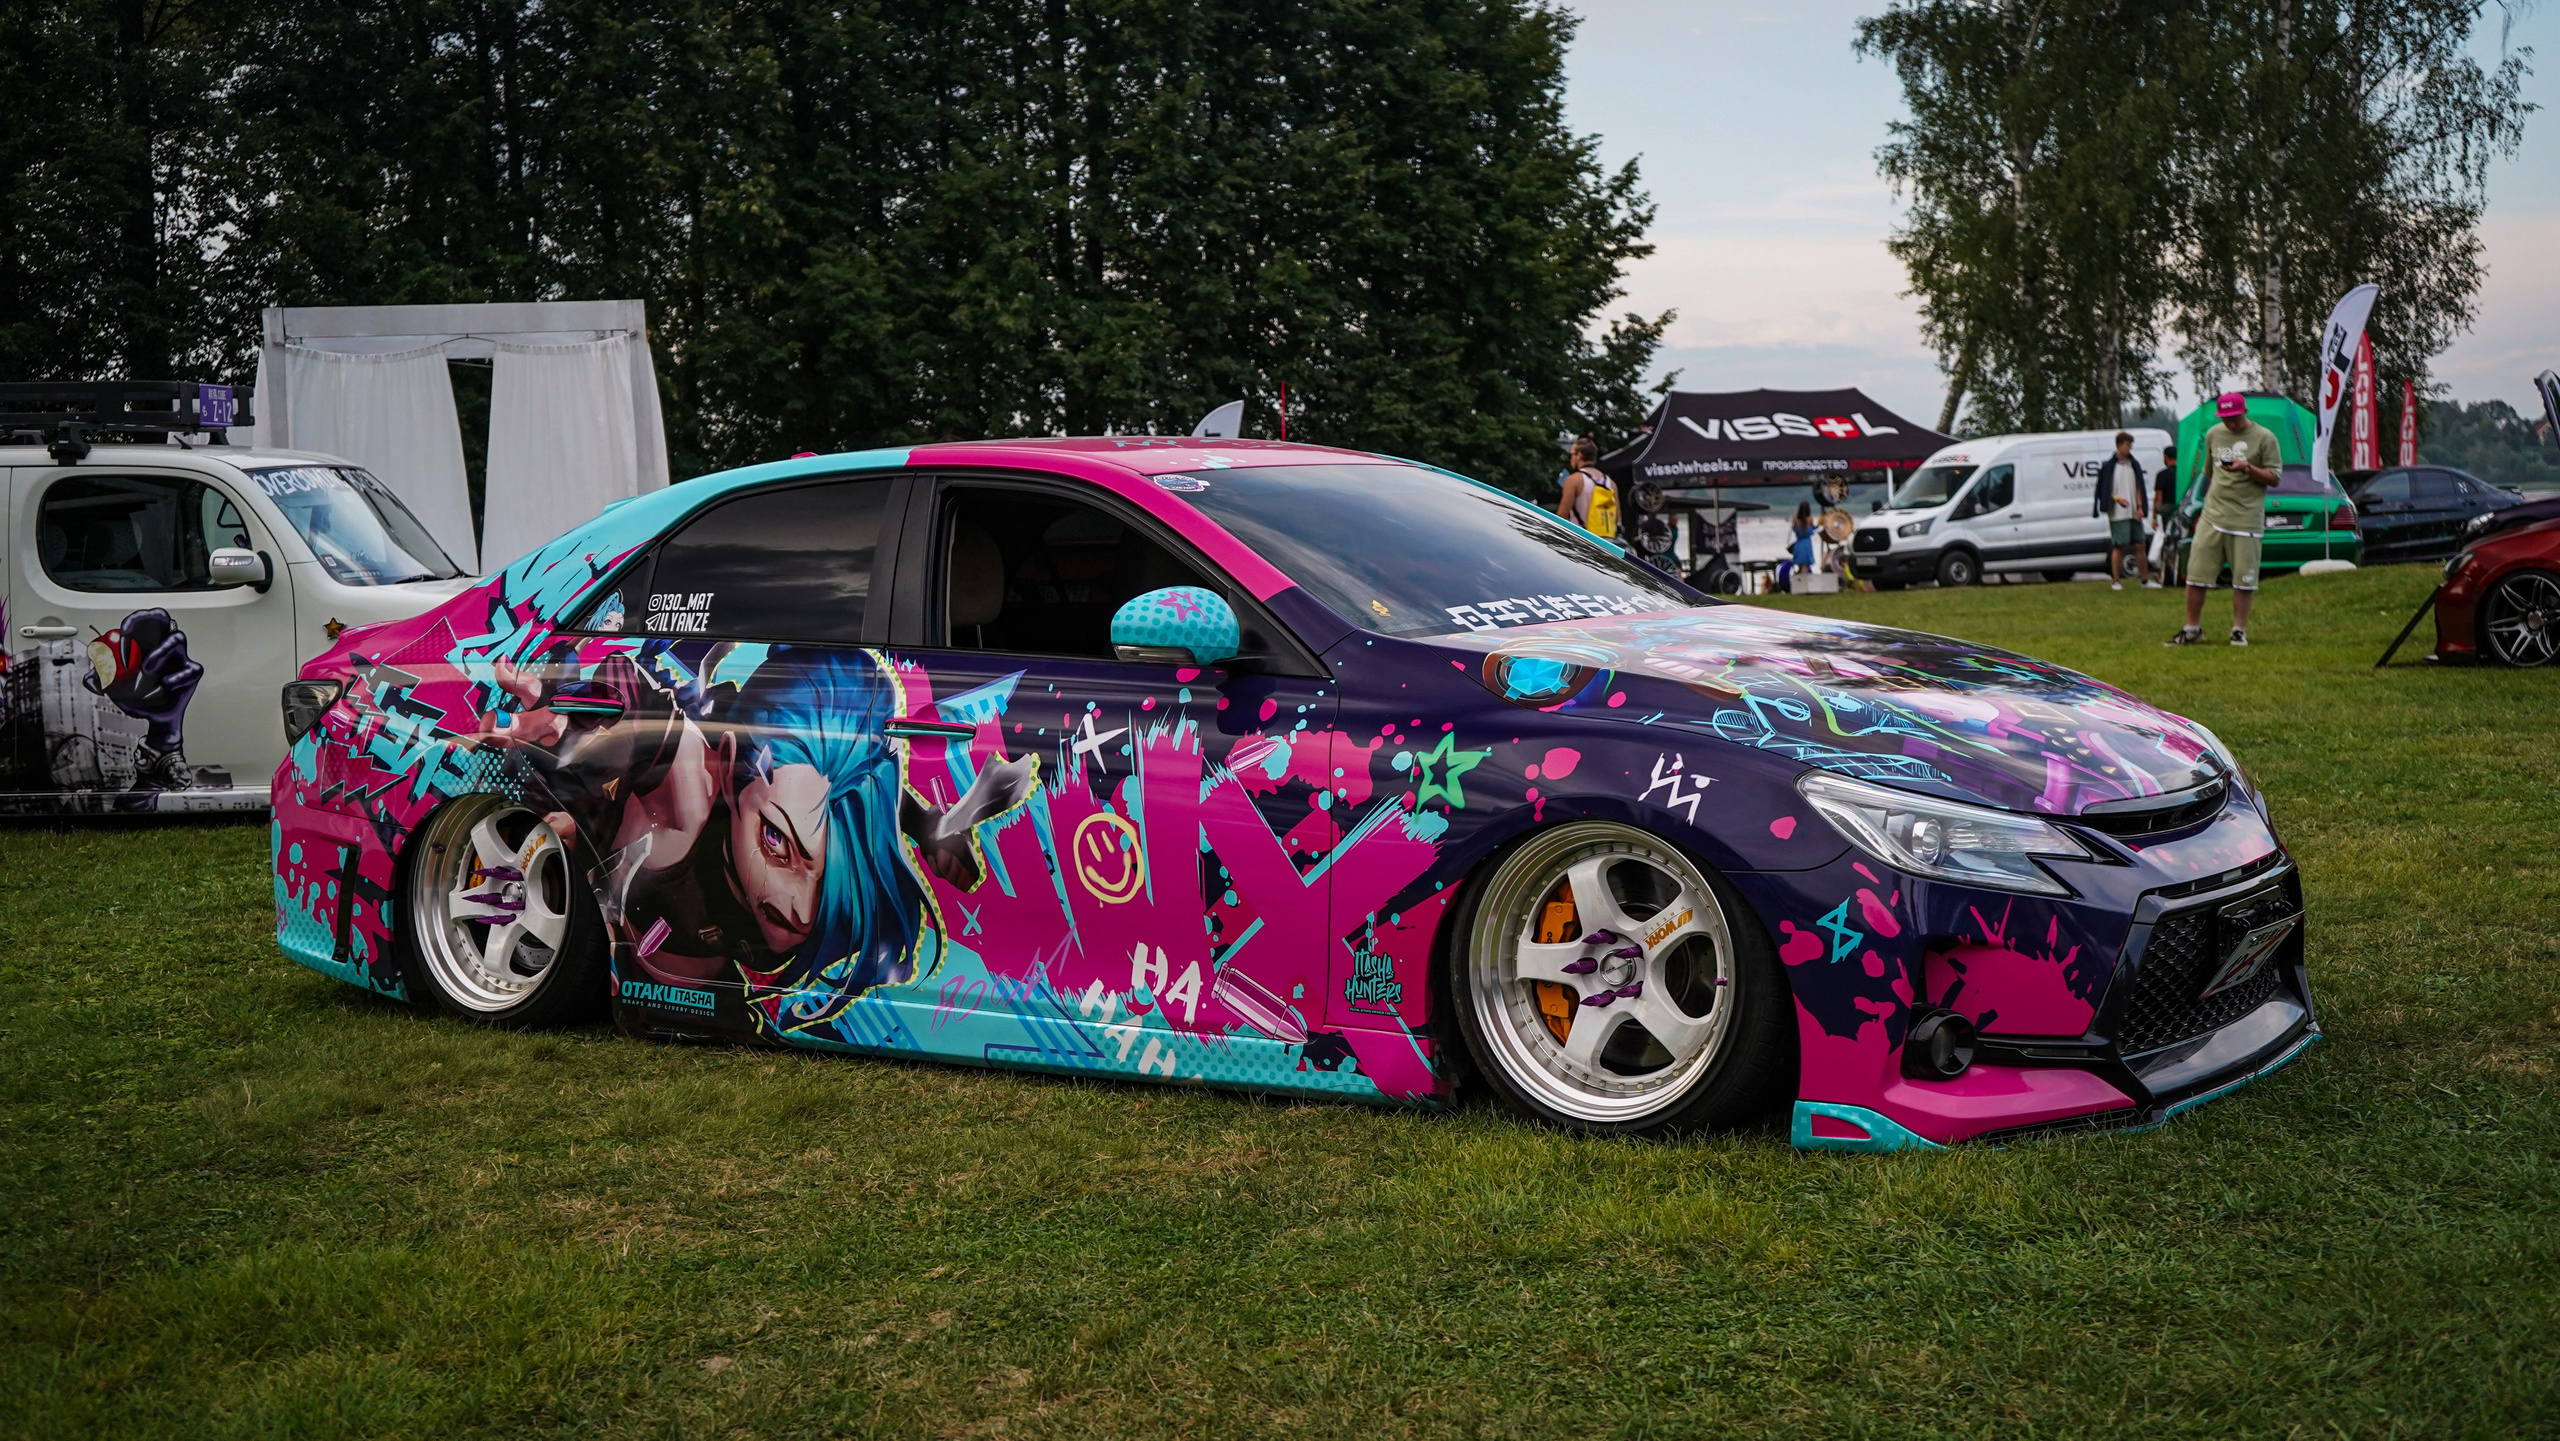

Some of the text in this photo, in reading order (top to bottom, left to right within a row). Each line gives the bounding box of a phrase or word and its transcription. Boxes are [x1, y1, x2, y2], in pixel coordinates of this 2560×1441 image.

[213, 400, 233, 422] Z-12
[1645, 457, 1748, 477] vissolwheels.ru
[1762, 459, 1849, 471] ПРОИЗВОДСТВО
[661, 592, 715, 611] 130_MAT
[658, 612, 710, 632] ILYANZE
[1354, 948, 1395, 985] ITASHA
[621, 981, 713, 1007] OTAKU ITASHA
[1131, 941, 1202, 1026] HA
[1344, 974, 1402, 1006] HUNTERS
[664, 1004, 688, 1012] LIVERY
[690, 1008, 715, 1017] DESIGN
